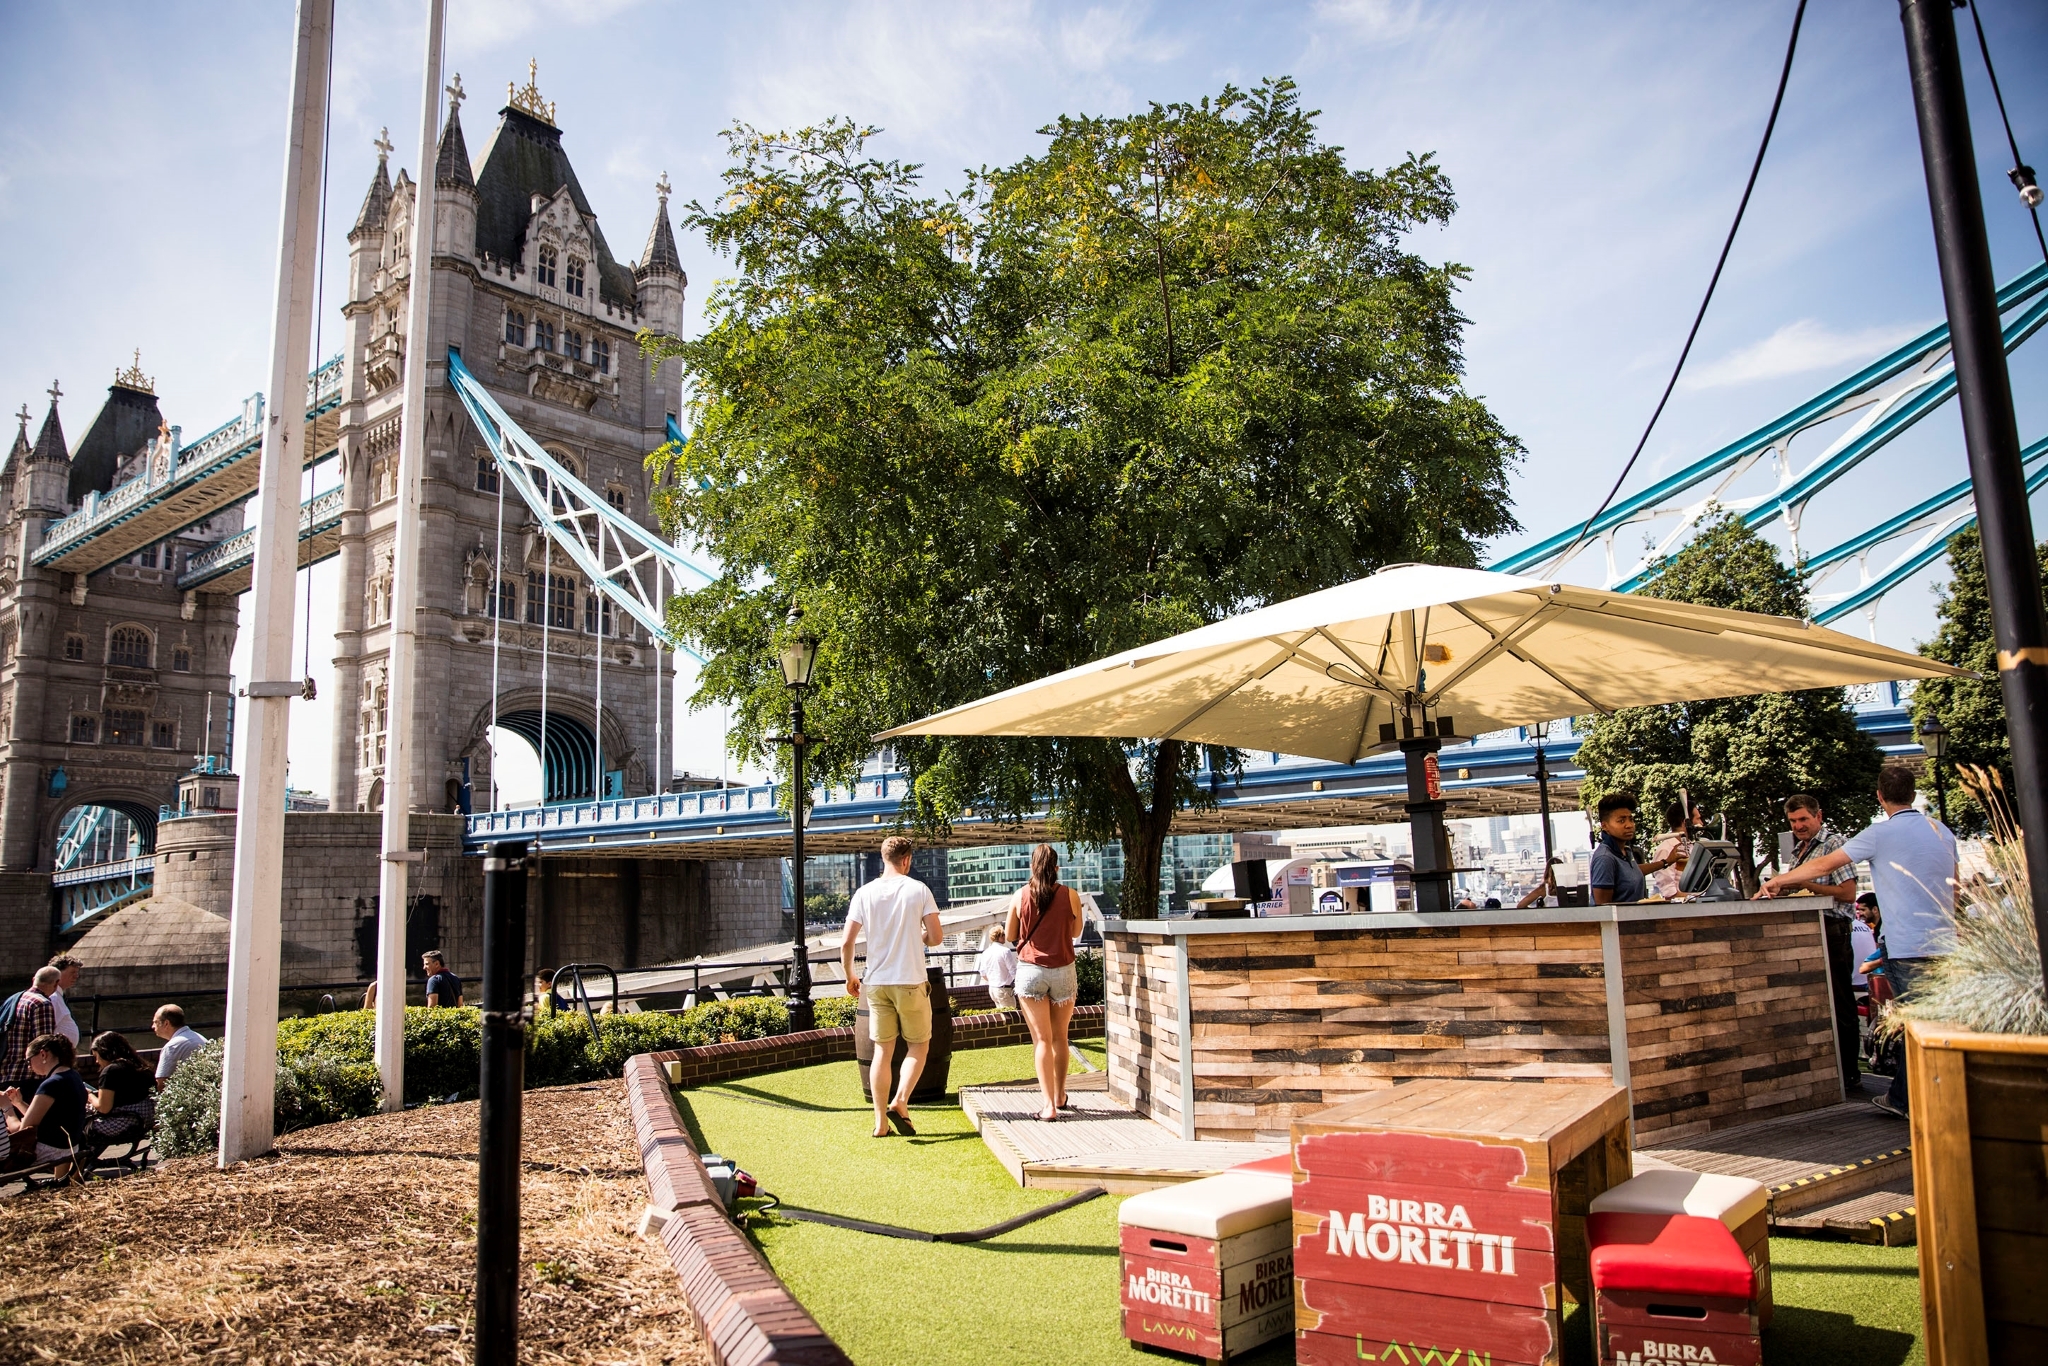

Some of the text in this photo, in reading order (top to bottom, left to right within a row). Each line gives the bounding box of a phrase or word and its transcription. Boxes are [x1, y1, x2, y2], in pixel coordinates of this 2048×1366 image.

[1367, 1194, 1477, 1231] BIRRA
[1325, 1209, 1519, 1277] MORETTI
[1146, 1267, 1193, 1290] BIRRA
[1255, 1254, 1294, 1281] BIRRA
[1128, 1274, 1211, 1315] MORETTI
[1239, 1271, 1294, 1316] MORET
[1142, 1318, 1197, 1342] LAWN
[1356, 1332, 1491, 1366] LAWN
[1643, 1339, 1719, 1362] BIRRA
